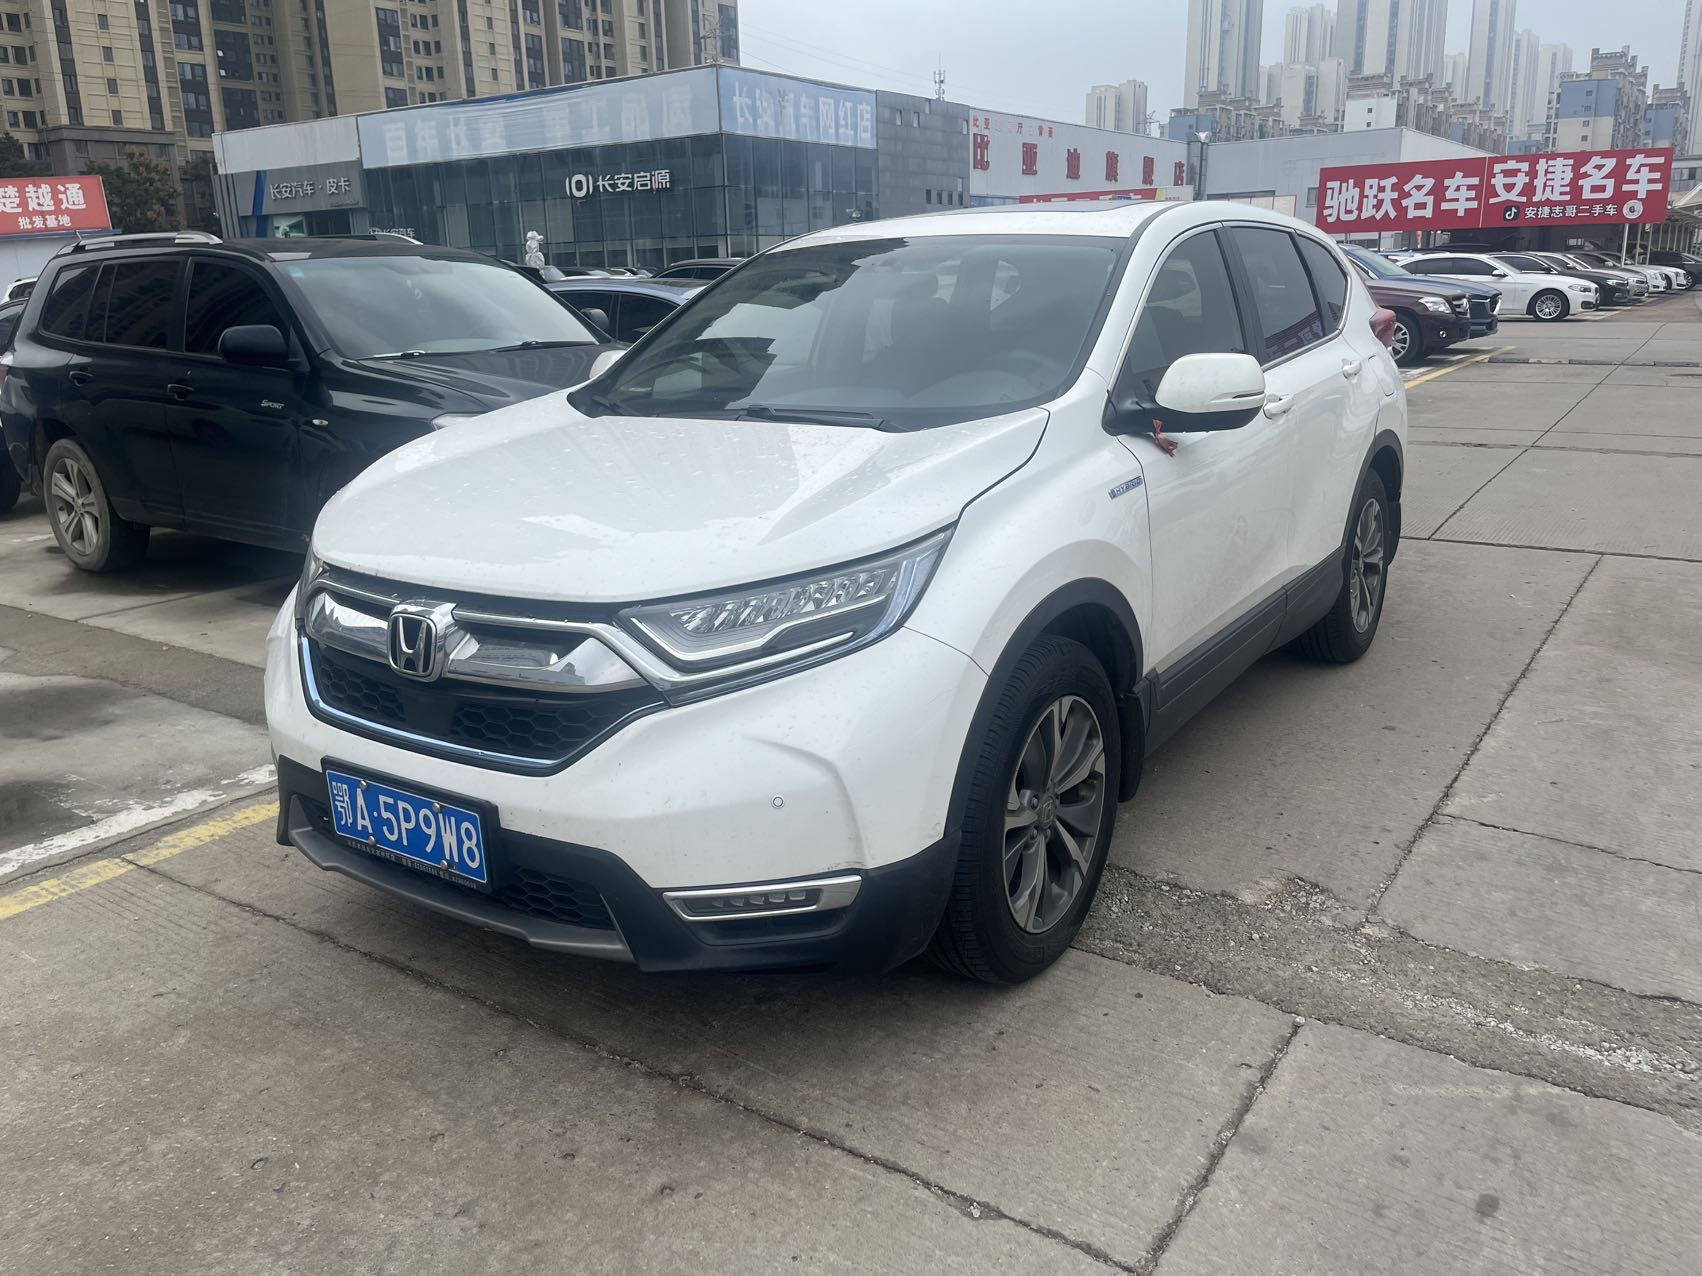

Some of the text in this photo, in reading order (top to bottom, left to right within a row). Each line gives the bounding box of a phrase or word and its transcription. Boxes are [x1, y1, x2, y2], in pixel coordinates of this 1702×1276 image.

[595, 170, 670, 193] 长安启源
[1322, 154, 1664, 223] 驰跃名车 安捷名车
[0, 184, 86, 212] 楚越通
[18, 215, 71, 229] 批发基地
[1524, 204, 1618, 219] 安捷志哥二手车
